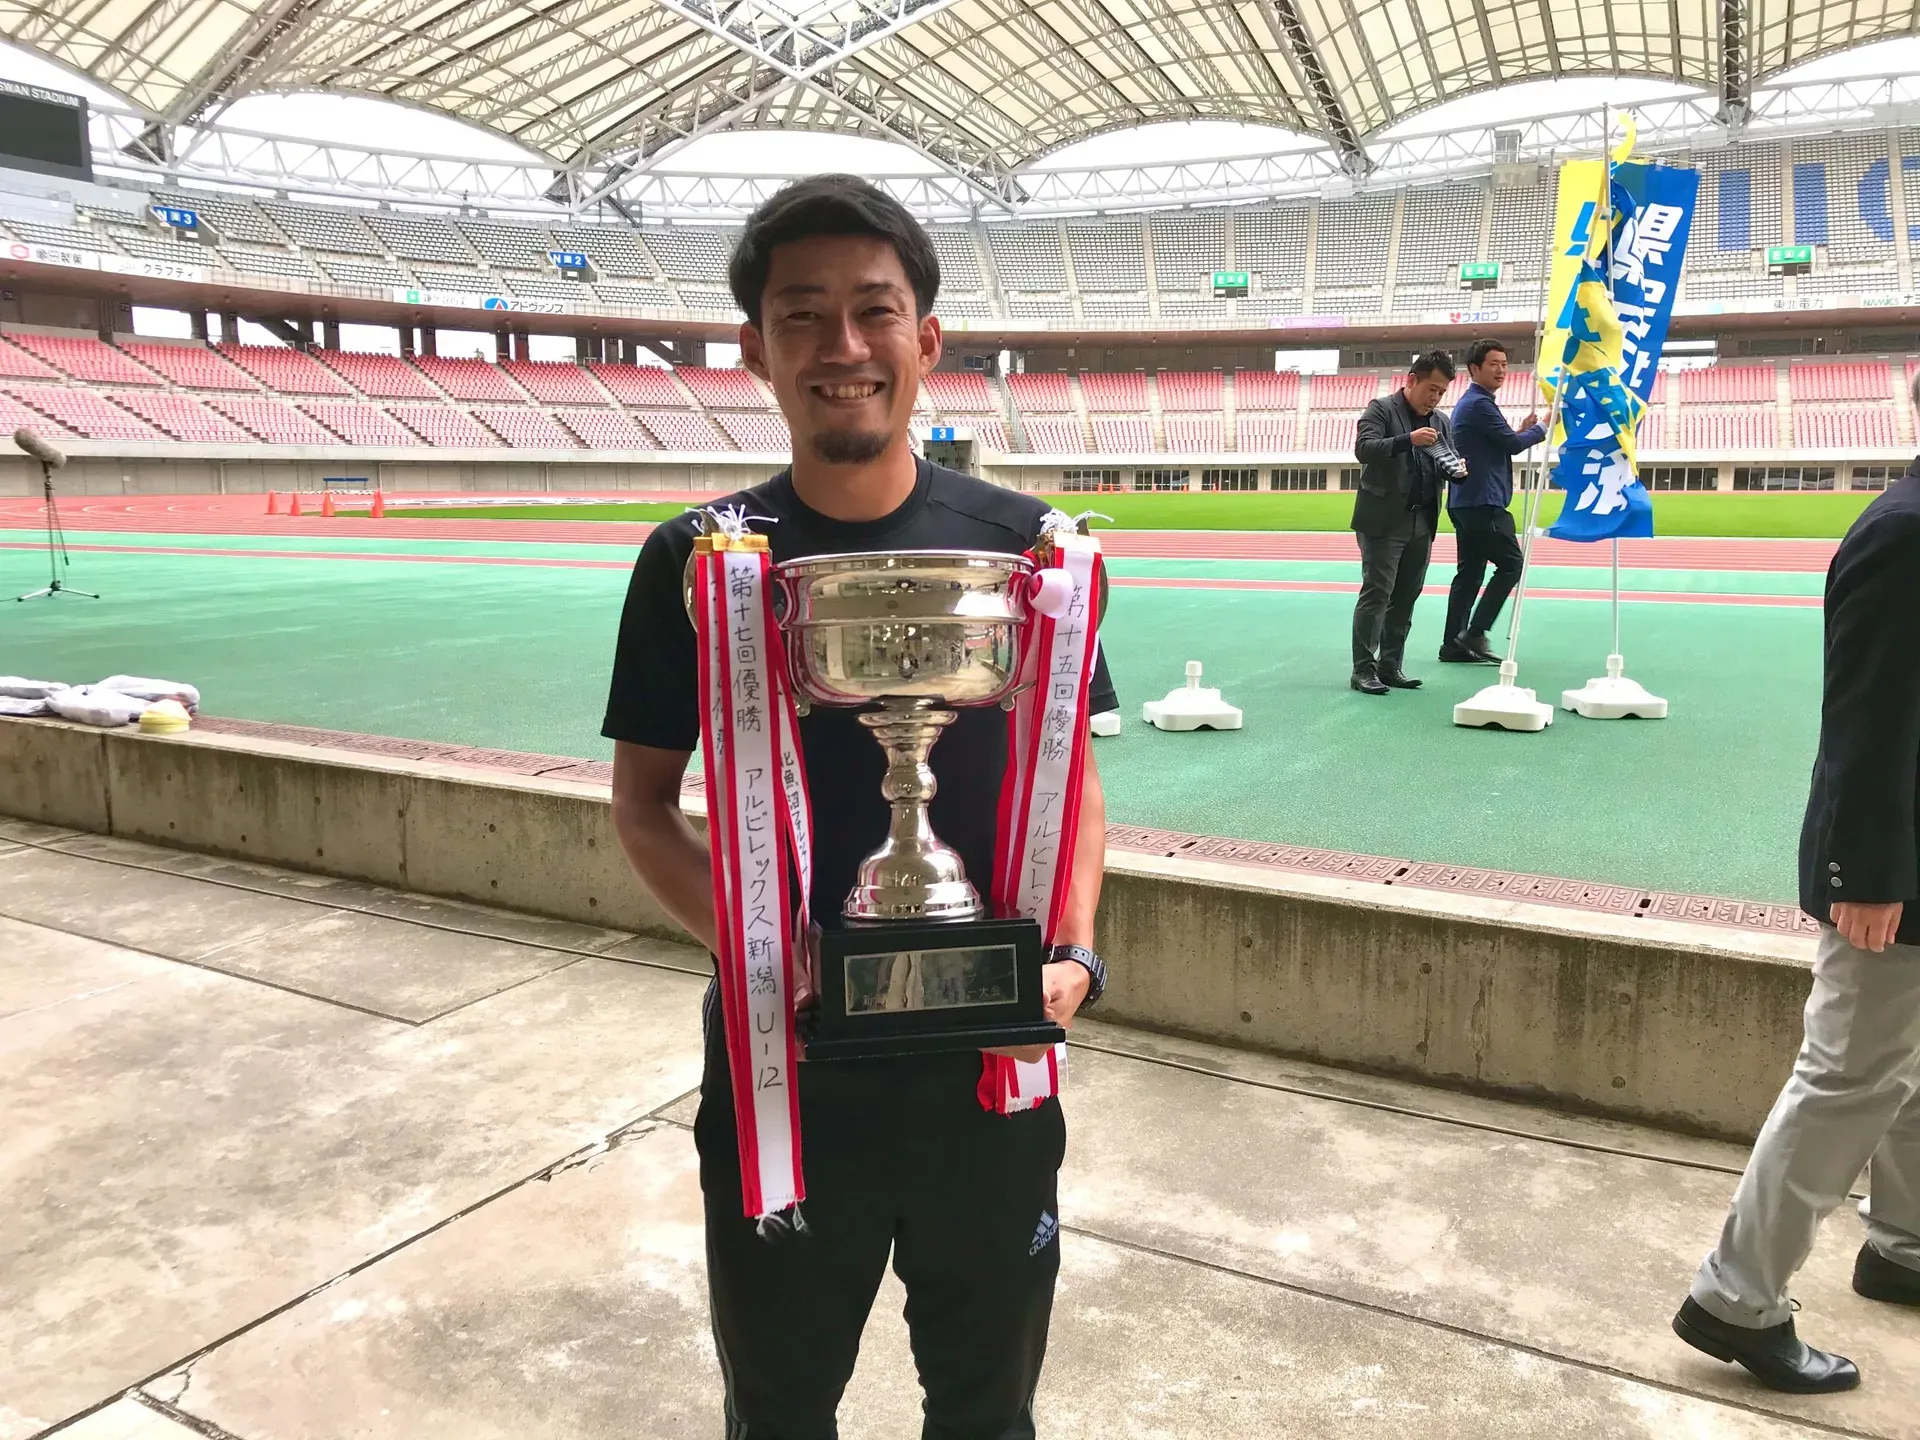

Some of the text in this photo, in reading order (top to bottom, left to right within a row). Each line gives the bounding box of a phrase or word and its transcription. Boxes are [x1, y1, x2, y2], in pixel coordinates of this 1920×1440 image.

[31, 87, 80, 107] STADIUM
[183, 213, 193, 225] 3
[574, 255, 583, 265] 2
[143, 263, 194, 279] クラフティ
[510, 300, 564, 314] アドヴァンス
[938, 428, 947, 439] 3
[730, 564, 784, 1092] 第十七回優勝 アルビレックス新潟 U-12
[1029, 1219, 1059, 1256] adidas
